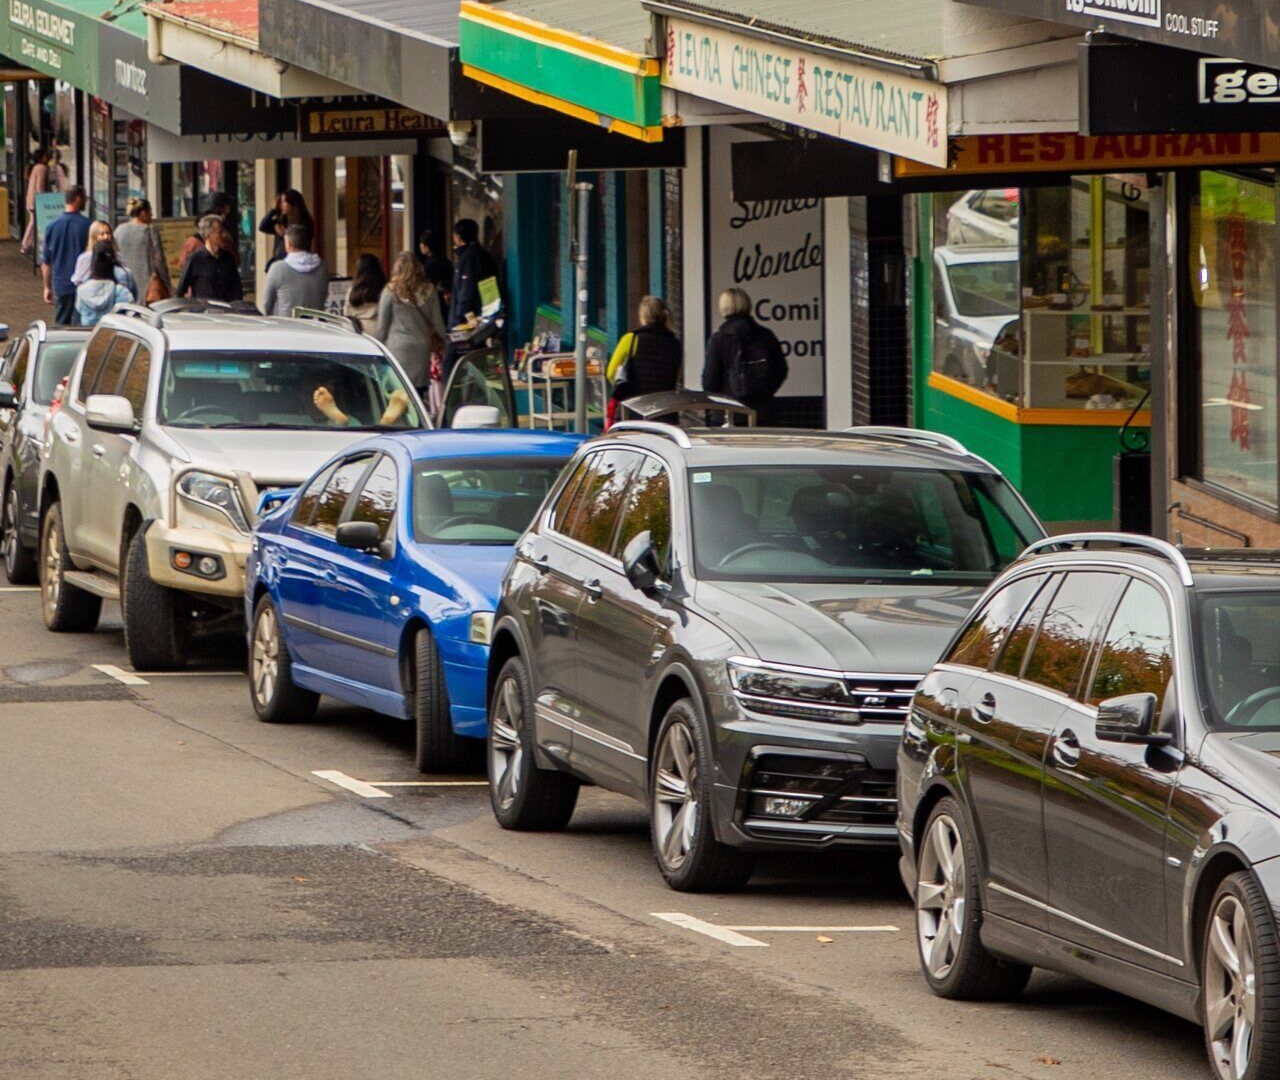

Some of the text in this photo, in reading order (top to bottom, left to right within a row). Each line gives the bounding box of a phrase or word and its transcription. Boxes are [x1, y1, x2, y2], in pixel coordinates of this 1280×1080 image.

[36, 8, 76, 47] GOURMET
[1164, 11, 1219, 39] COOL STUFF
[732, 44, 792, 106] CHINESE
[813, 65, 924, 142] RESTAURANT
[319, 112, 375, 133] Leura
[978, 131, 1263, 164] RESTAURANT
[755, 297, 819, 321] Comi
[778, 338, 823, 357] oon
